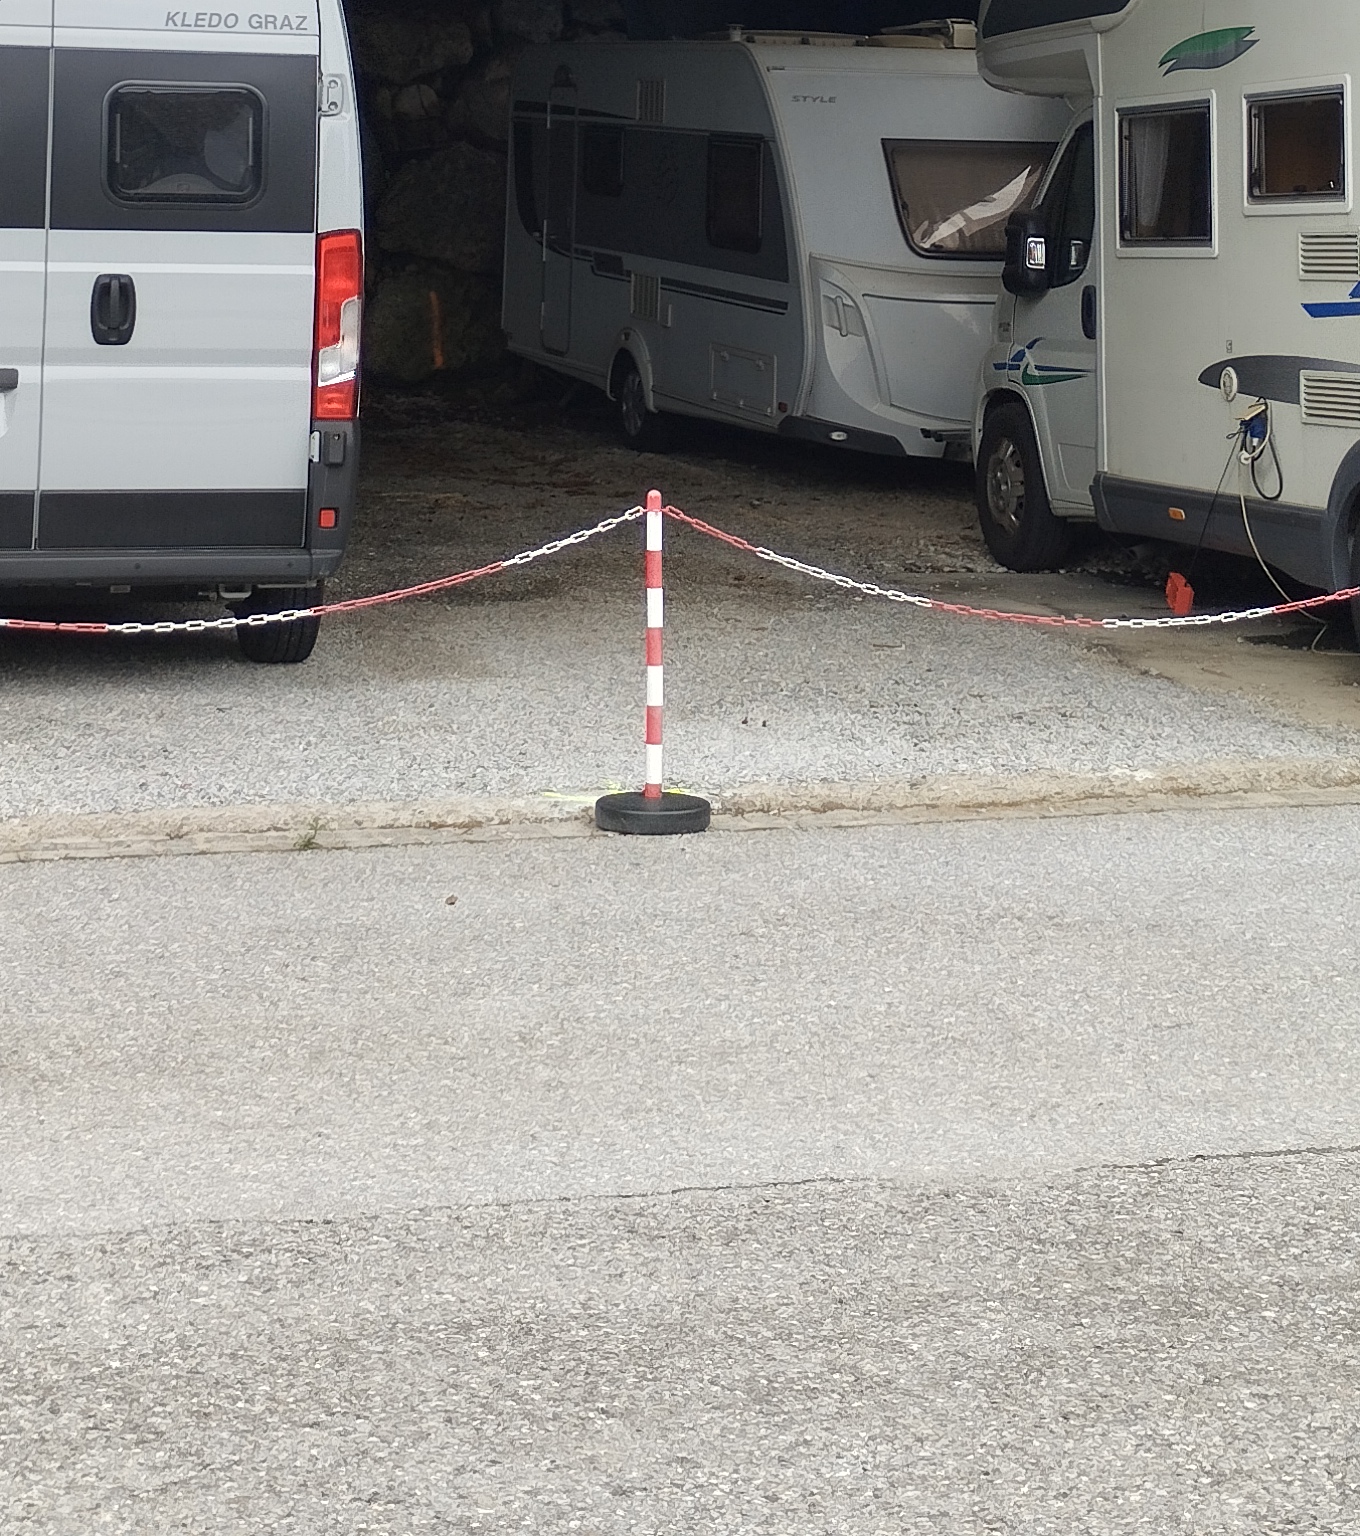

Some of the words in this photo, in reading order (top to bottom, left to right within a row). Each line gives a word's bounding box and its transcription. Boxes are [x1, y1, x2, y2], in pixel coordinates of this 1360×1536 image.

[165, 11, 239, 29] KLEDO
[247, 13, 308, 31] GRAZ
[791, 95, 837, 104] STYLE
